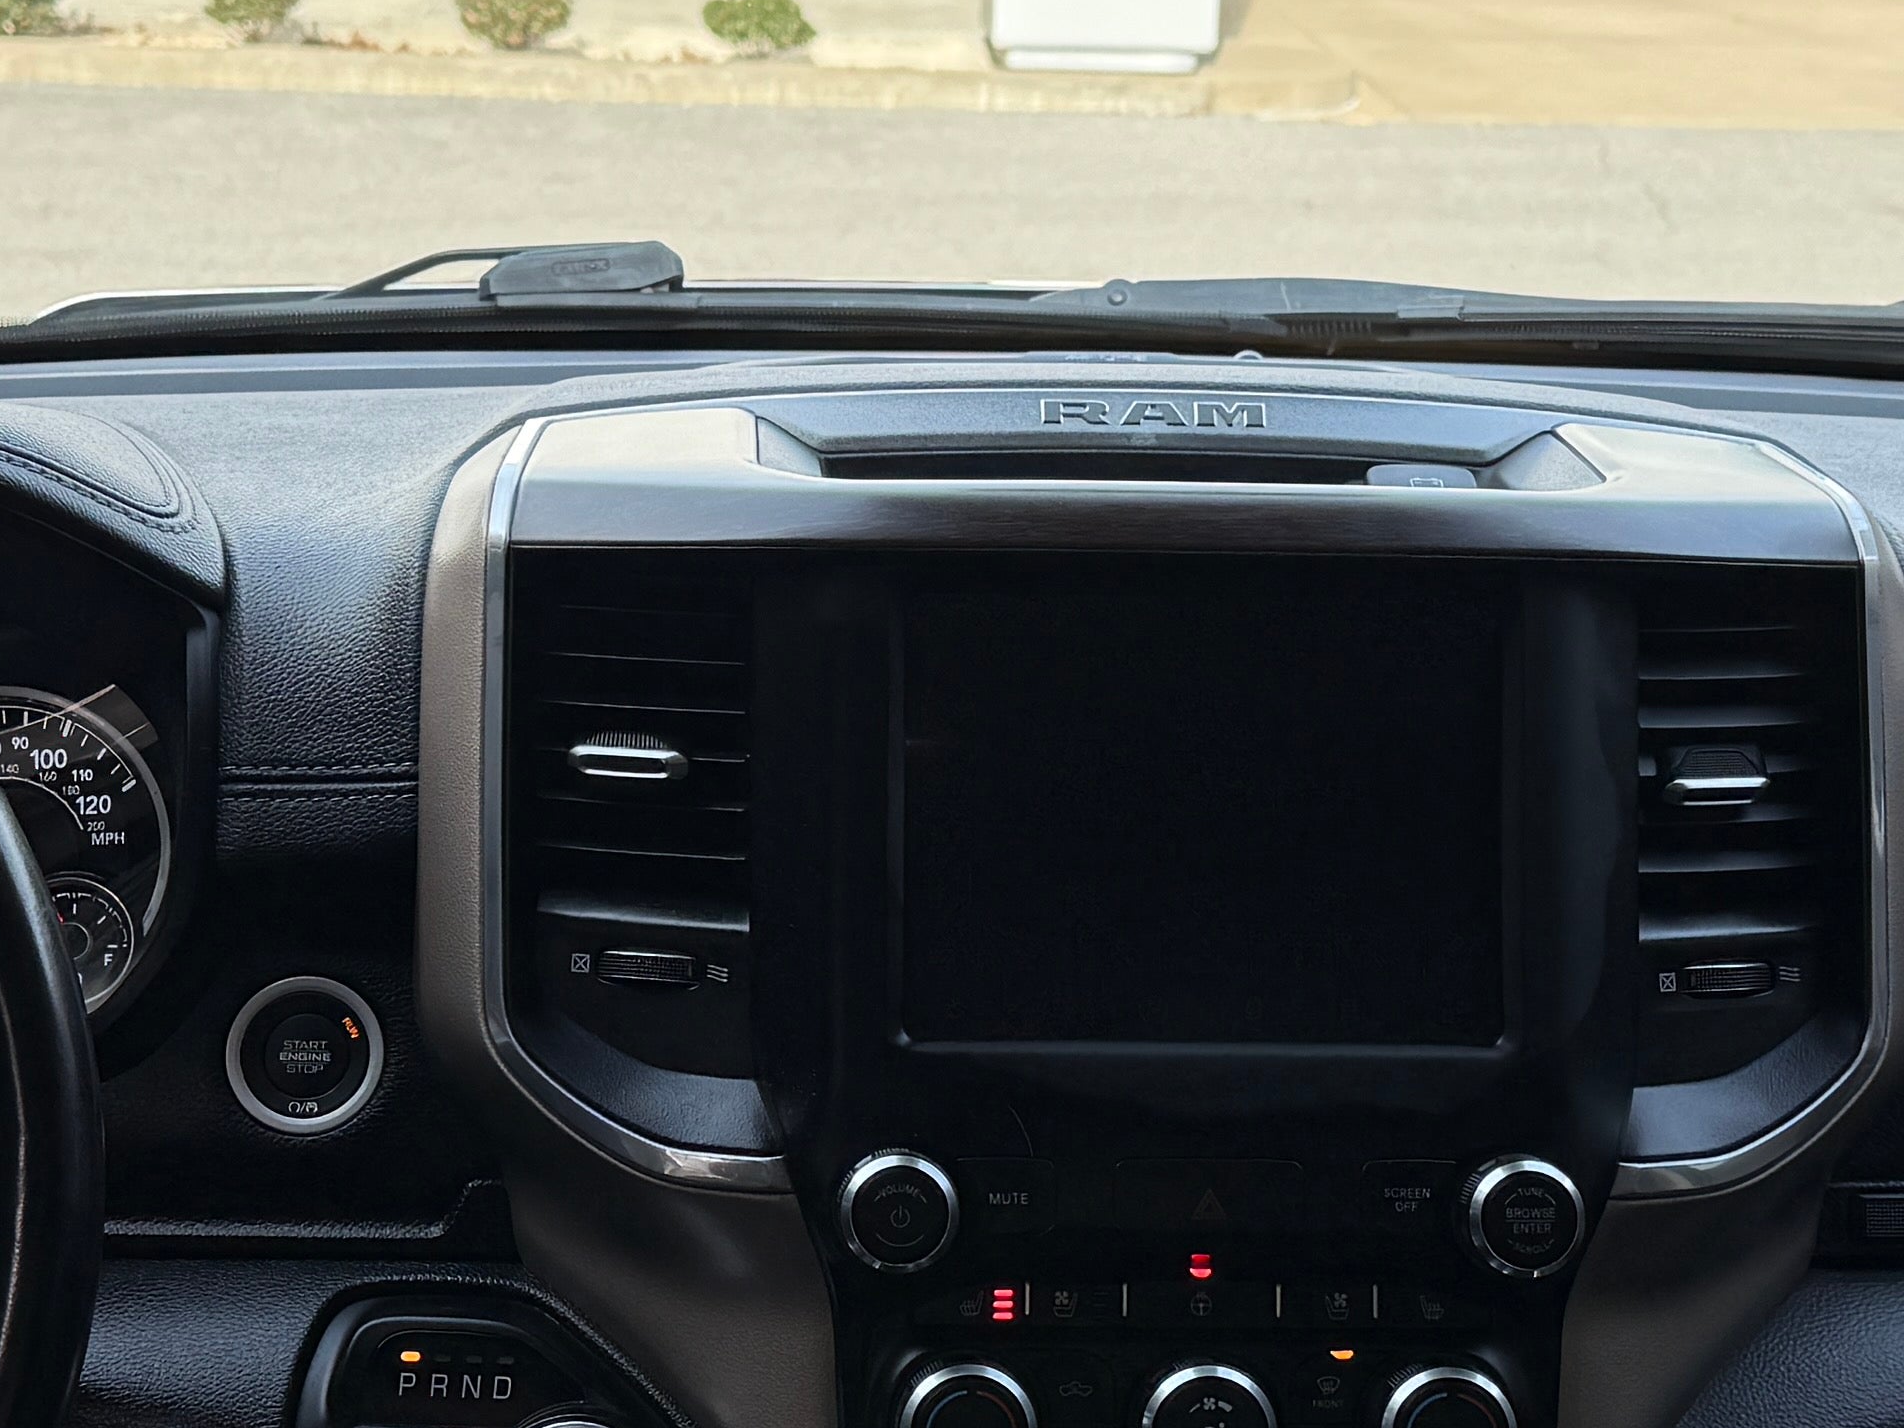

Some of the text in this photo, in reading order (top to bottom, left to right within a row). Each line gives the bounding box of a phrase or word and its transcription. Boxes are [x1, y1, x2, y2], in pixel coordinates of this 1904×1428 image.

[1040, 399, 1266, 428] RAM
[11, 737, 29, 750] 90
[29, 749, 68, 769] 100
[71, 768, 94, 782] 110
[75, 795, 112, 815] 120
[91, 831, 125, 846] MPH
[104, 954, 112, 966] F
[282, 1039, 329, 1051] START
[279, 1052, 332, 1062] ENGINE
[286, 1063, 324, 1074] STOP
[878, 1183, 921, 1198] VOLUME
[1384, 1187, 1430, 1199] SCREEN
[1518, 1187, 1545, 1198] TUNE
[988, 1192, 1029, 1205] MUTE
[1395, 1201, 1418, 1212] OFF
[1506, 1207, 1556, 1219] BROWSE
[1513, 1223, 1552, 1234] ENTER
[398, 1373, 512, 1399] P R N D
